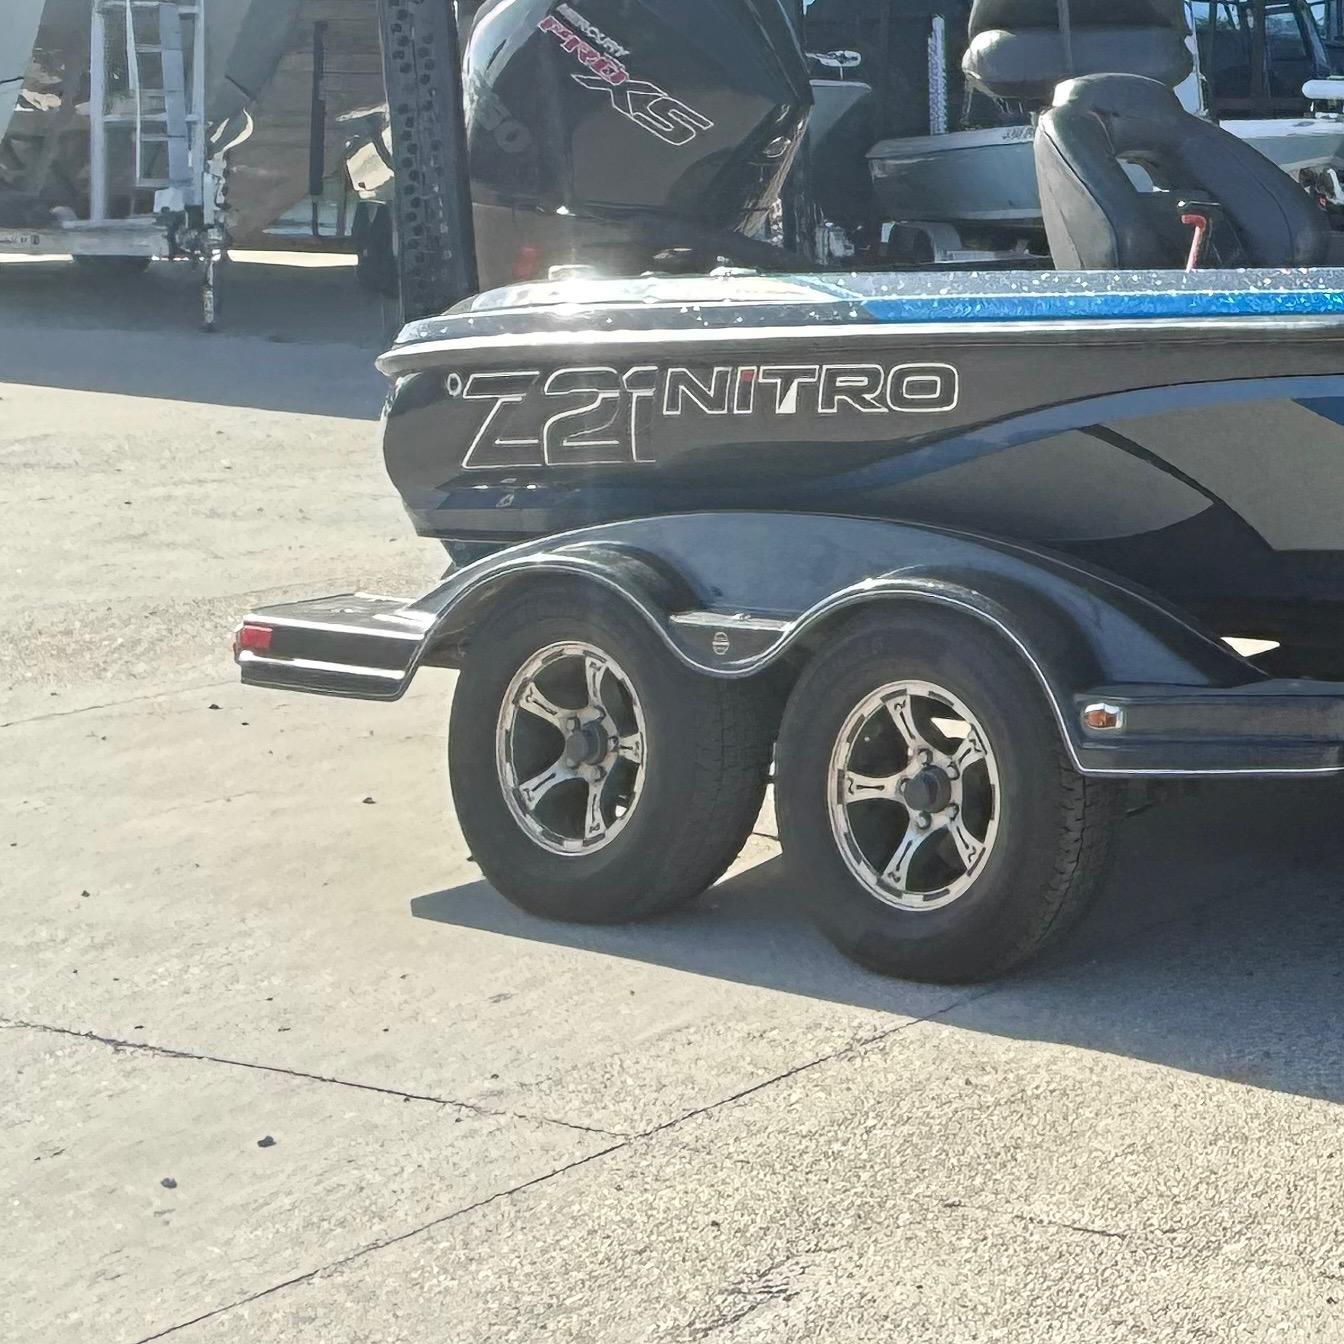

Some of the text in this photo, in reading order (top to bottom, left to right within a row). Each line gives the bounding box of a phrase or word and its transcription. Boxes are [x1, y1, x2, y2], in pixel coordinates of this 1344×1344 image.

[537, 15, 714, 146] PRO XS
[461, 362, 959, 469] Z21 NITRO
